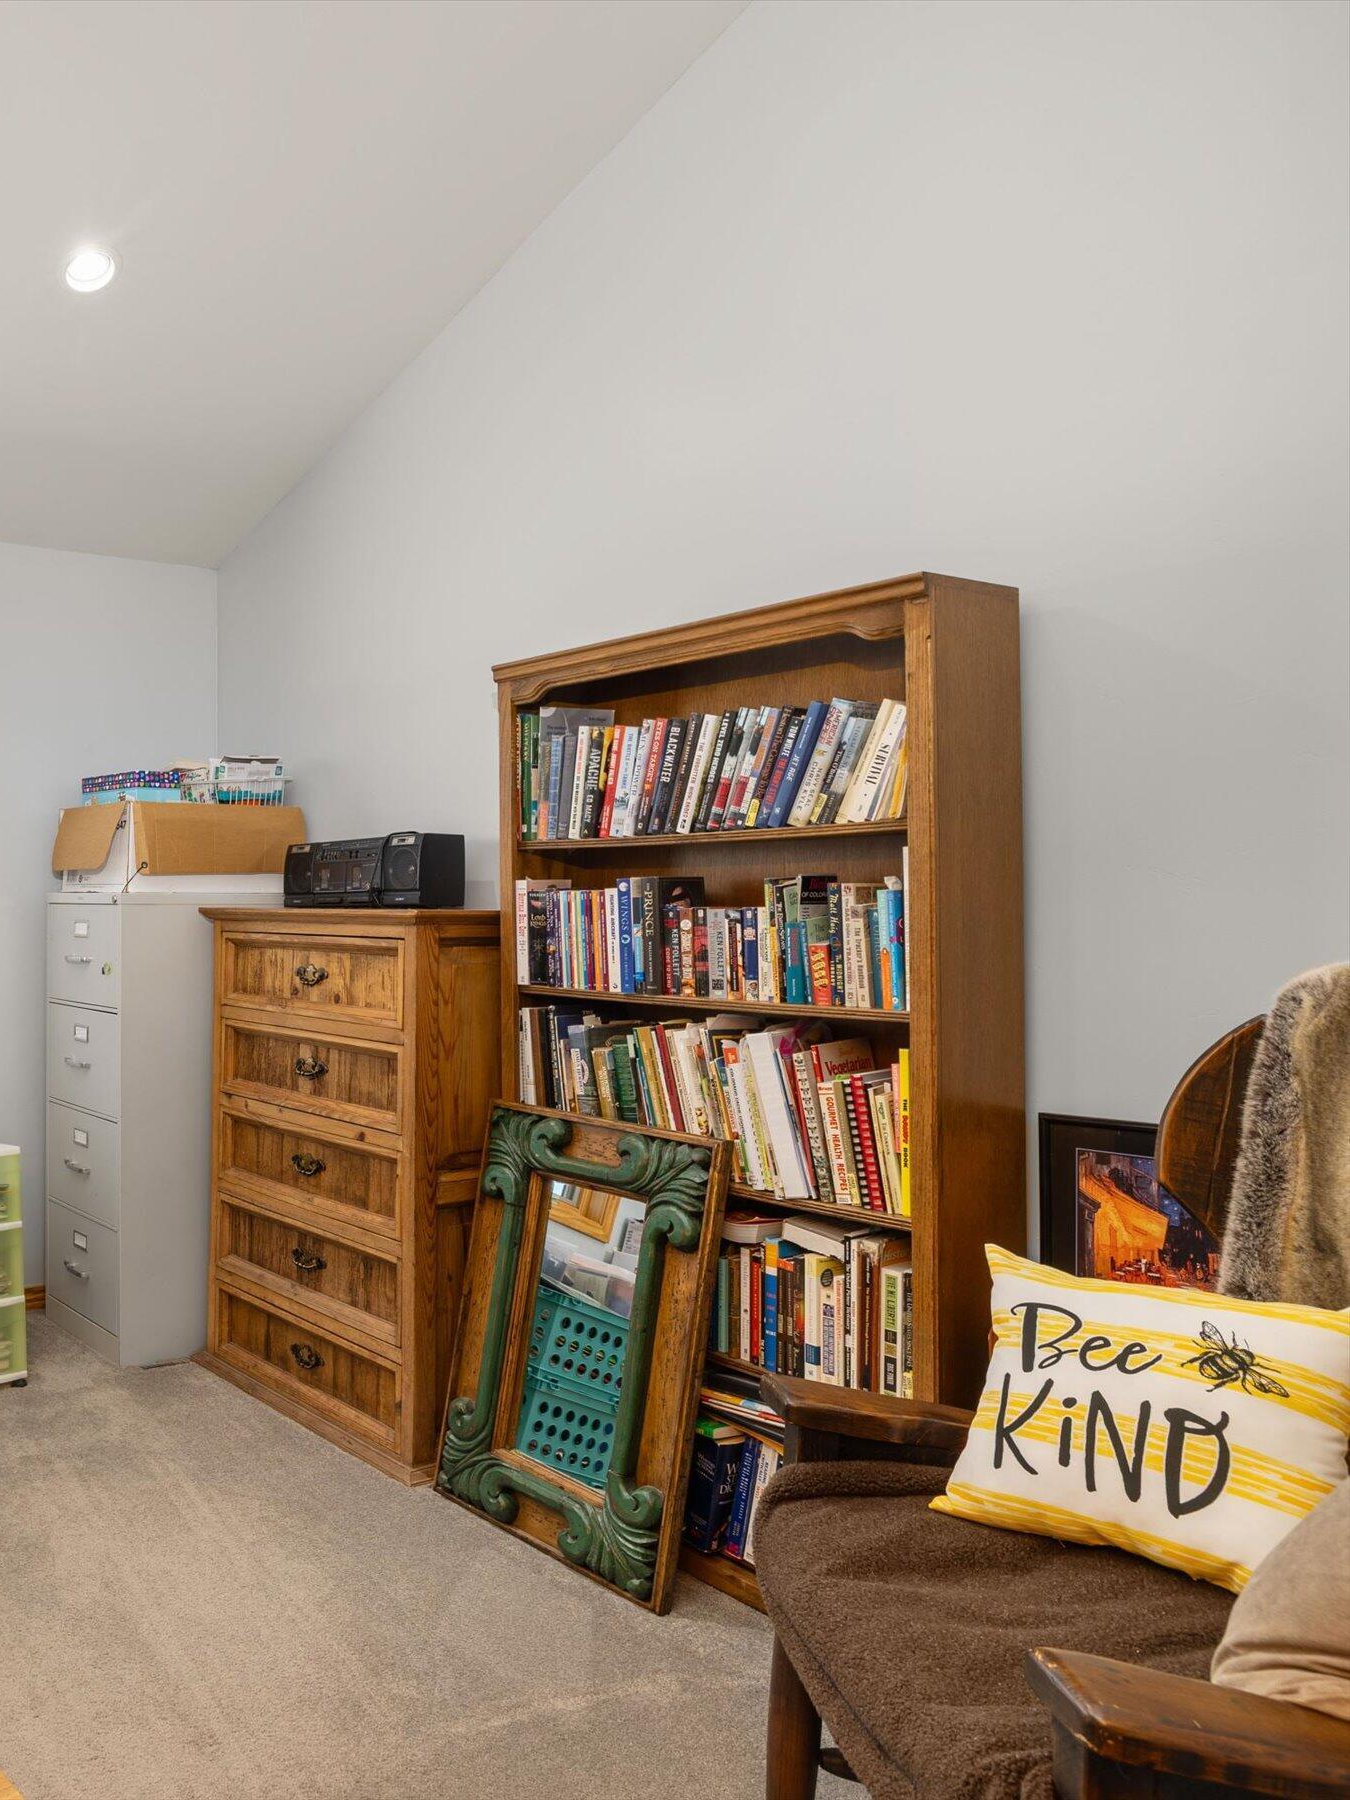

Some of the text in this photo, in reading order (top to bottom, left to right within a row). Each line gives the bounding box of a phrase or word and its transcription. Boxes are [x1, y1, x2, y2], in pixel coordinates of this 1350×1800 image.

[718, 718, 729, 738] LEVEL
[787, 724, 797, 739] TOM
[818, 705, 836, 744] SNIPER
[825, 709, 843, 746] AMERICAN
[585, 748, 602, 790] APACHE
[645, 720, 662, 781] EYES ON TARGET
[659, 726, 681, 782] BLACKWATER
[706, 756, 719, 782] HEROES
[790, 753, 800, 767] JET
[864, 741, 891, 787] SURVIVAL
[796, 761, 817, 810] CHRIS KYLE
[812, 767, 822, 786] NAVY
[583, 804, 591, 822] MACY
[804, 788, 815, 807] SEAL
[620, 895, 629, 930] WINGS
[643, 890, 654, 936] PRINCE
[828, 893, 840, 933] Matt Haig
[835, 964, 843, 992] MIDNIGHT
[825, 1056, 872, 1076] Vegetarian
[825, 1096, 848, 1190] GOURMET HEALTH RECIPES
[1010, 1302, 1163, 1375] Bee
